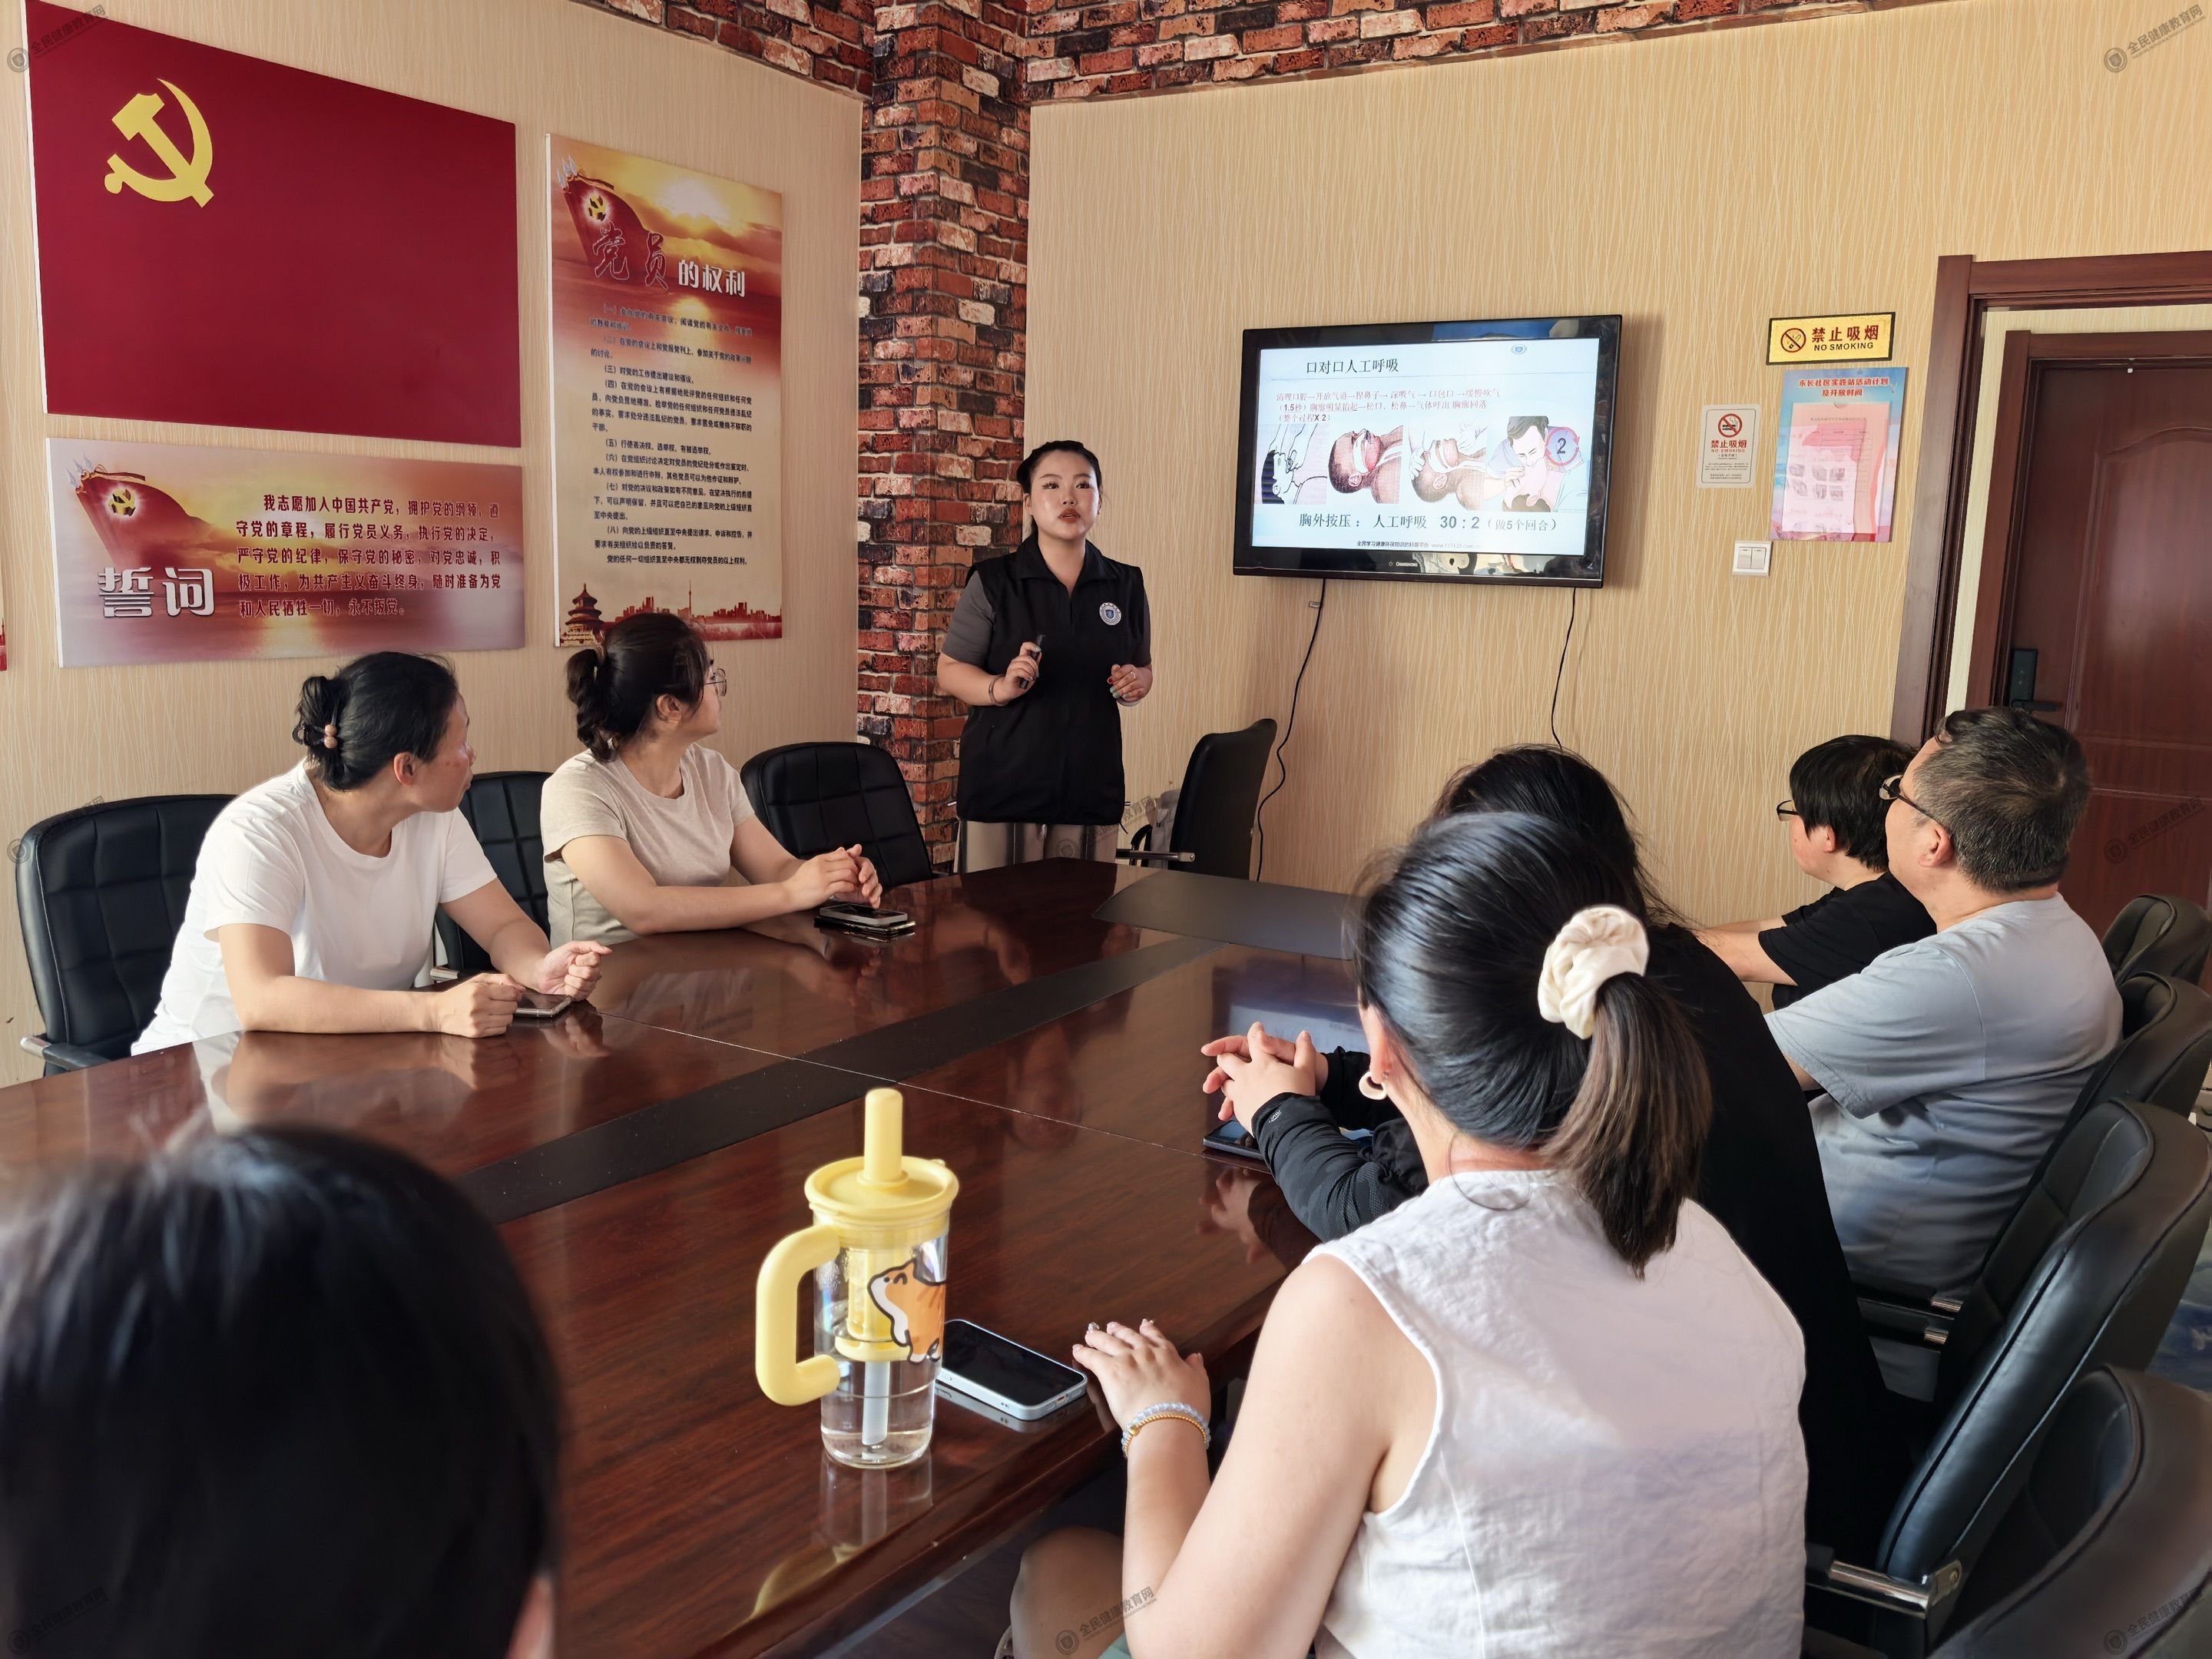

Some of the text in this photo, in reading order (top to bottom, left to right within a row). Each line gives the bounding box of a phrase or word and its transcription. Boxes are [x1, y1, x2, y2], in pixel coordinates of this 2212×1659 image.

[1812, 325, 1879, 343] 禁止吸烟
[1306, 359, 1399, 375] 口对口人工呼吸
[1556, 438, 1567, 455] 2
[1710, 439, 1747, 449] 禁止吸烟
[1373, 514, 1427, 528] 人工呼吸
[98, 567, 214, 618] 誓词
